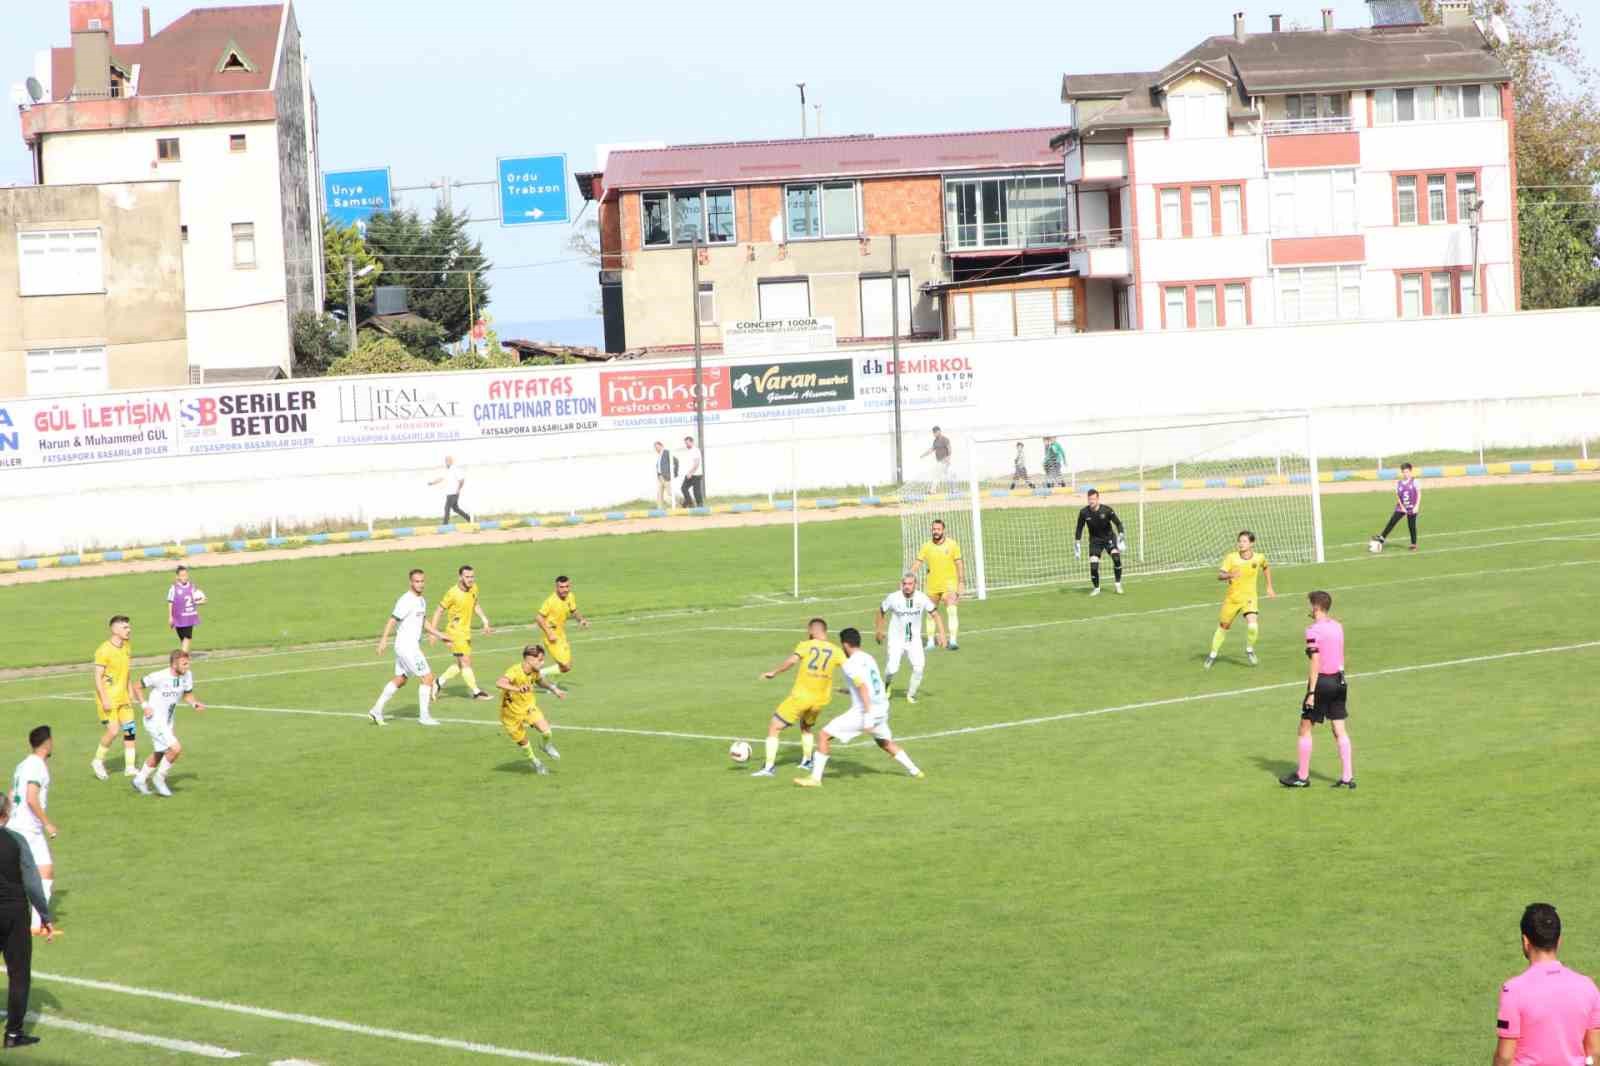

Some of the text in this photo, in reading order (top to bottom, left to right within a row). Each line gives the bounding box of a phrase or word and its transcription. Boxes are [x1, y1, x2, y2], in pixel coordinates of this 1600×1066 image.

[507, 172, 537, 183] Ordu
[507, 183, 560, 196] Trabzon
[334, 195, 384, 208] Samsun
[736, 318, 818, 330] CONCEPT 1000A
[886, 354, 972, 375] DEMİRKOL
[753, 365, 817, 393] Varan
[608, 377, 721, 403] hünkar
[34, 398, 171, 433] GÜL İLETİŞİM
[555, 397, 597, 417] BETON
[610, 401, 671, 415] restoran
[231, 413, 308, 437] BETON
[39, 438, 70, 450] Harun
[73, 436, 81, 448] &
[85, 431, 143, 447] Muhammed
[808, 646, 833, 673] 27
